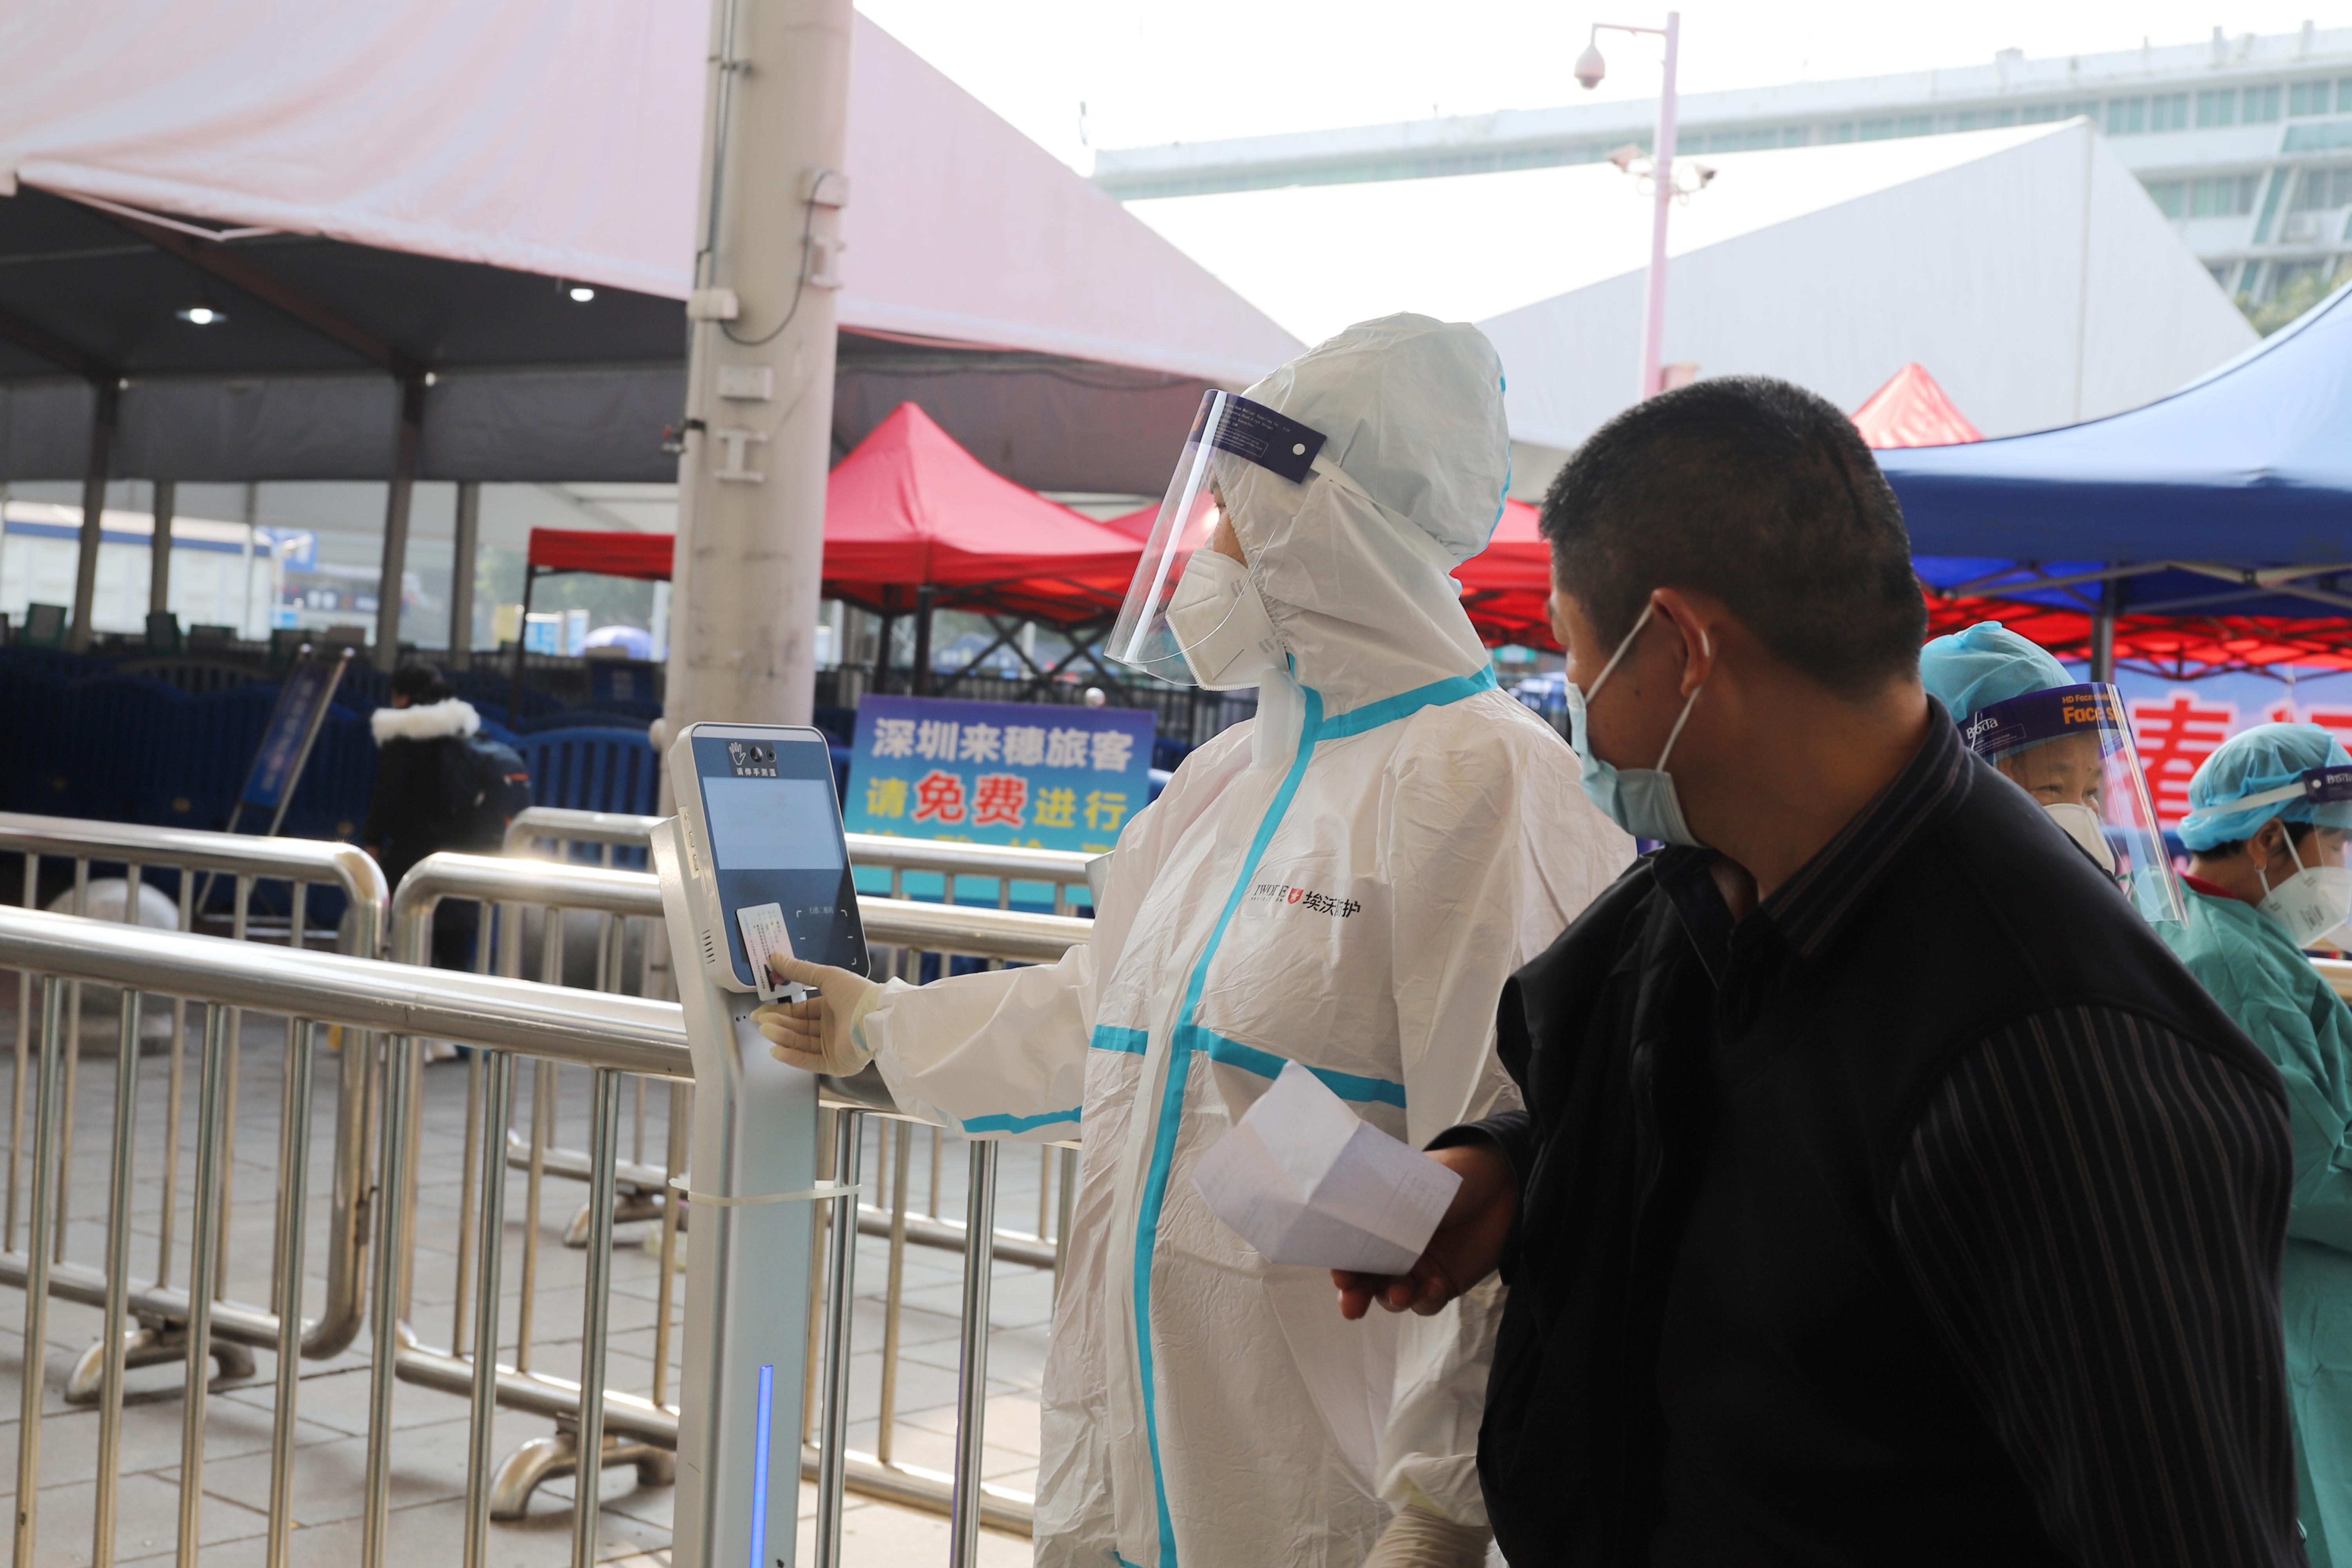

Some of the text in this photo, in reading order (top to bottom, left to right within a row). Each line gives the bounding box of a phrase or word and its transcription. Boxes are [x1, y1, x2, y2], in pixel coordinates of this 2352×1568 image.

[2062, 695, 2074, 704] HD
[2075, 694, 2093, 702] Face
[2063, 706, 2105, 725] Face
[1966, 718, 1998, 739] Boda
[871, 718, 1134, 772] 深圳来穗旅客
[737, 767, 777, 777] 请伸手测温
[866, 769, 1127, 832] 请免费进行
